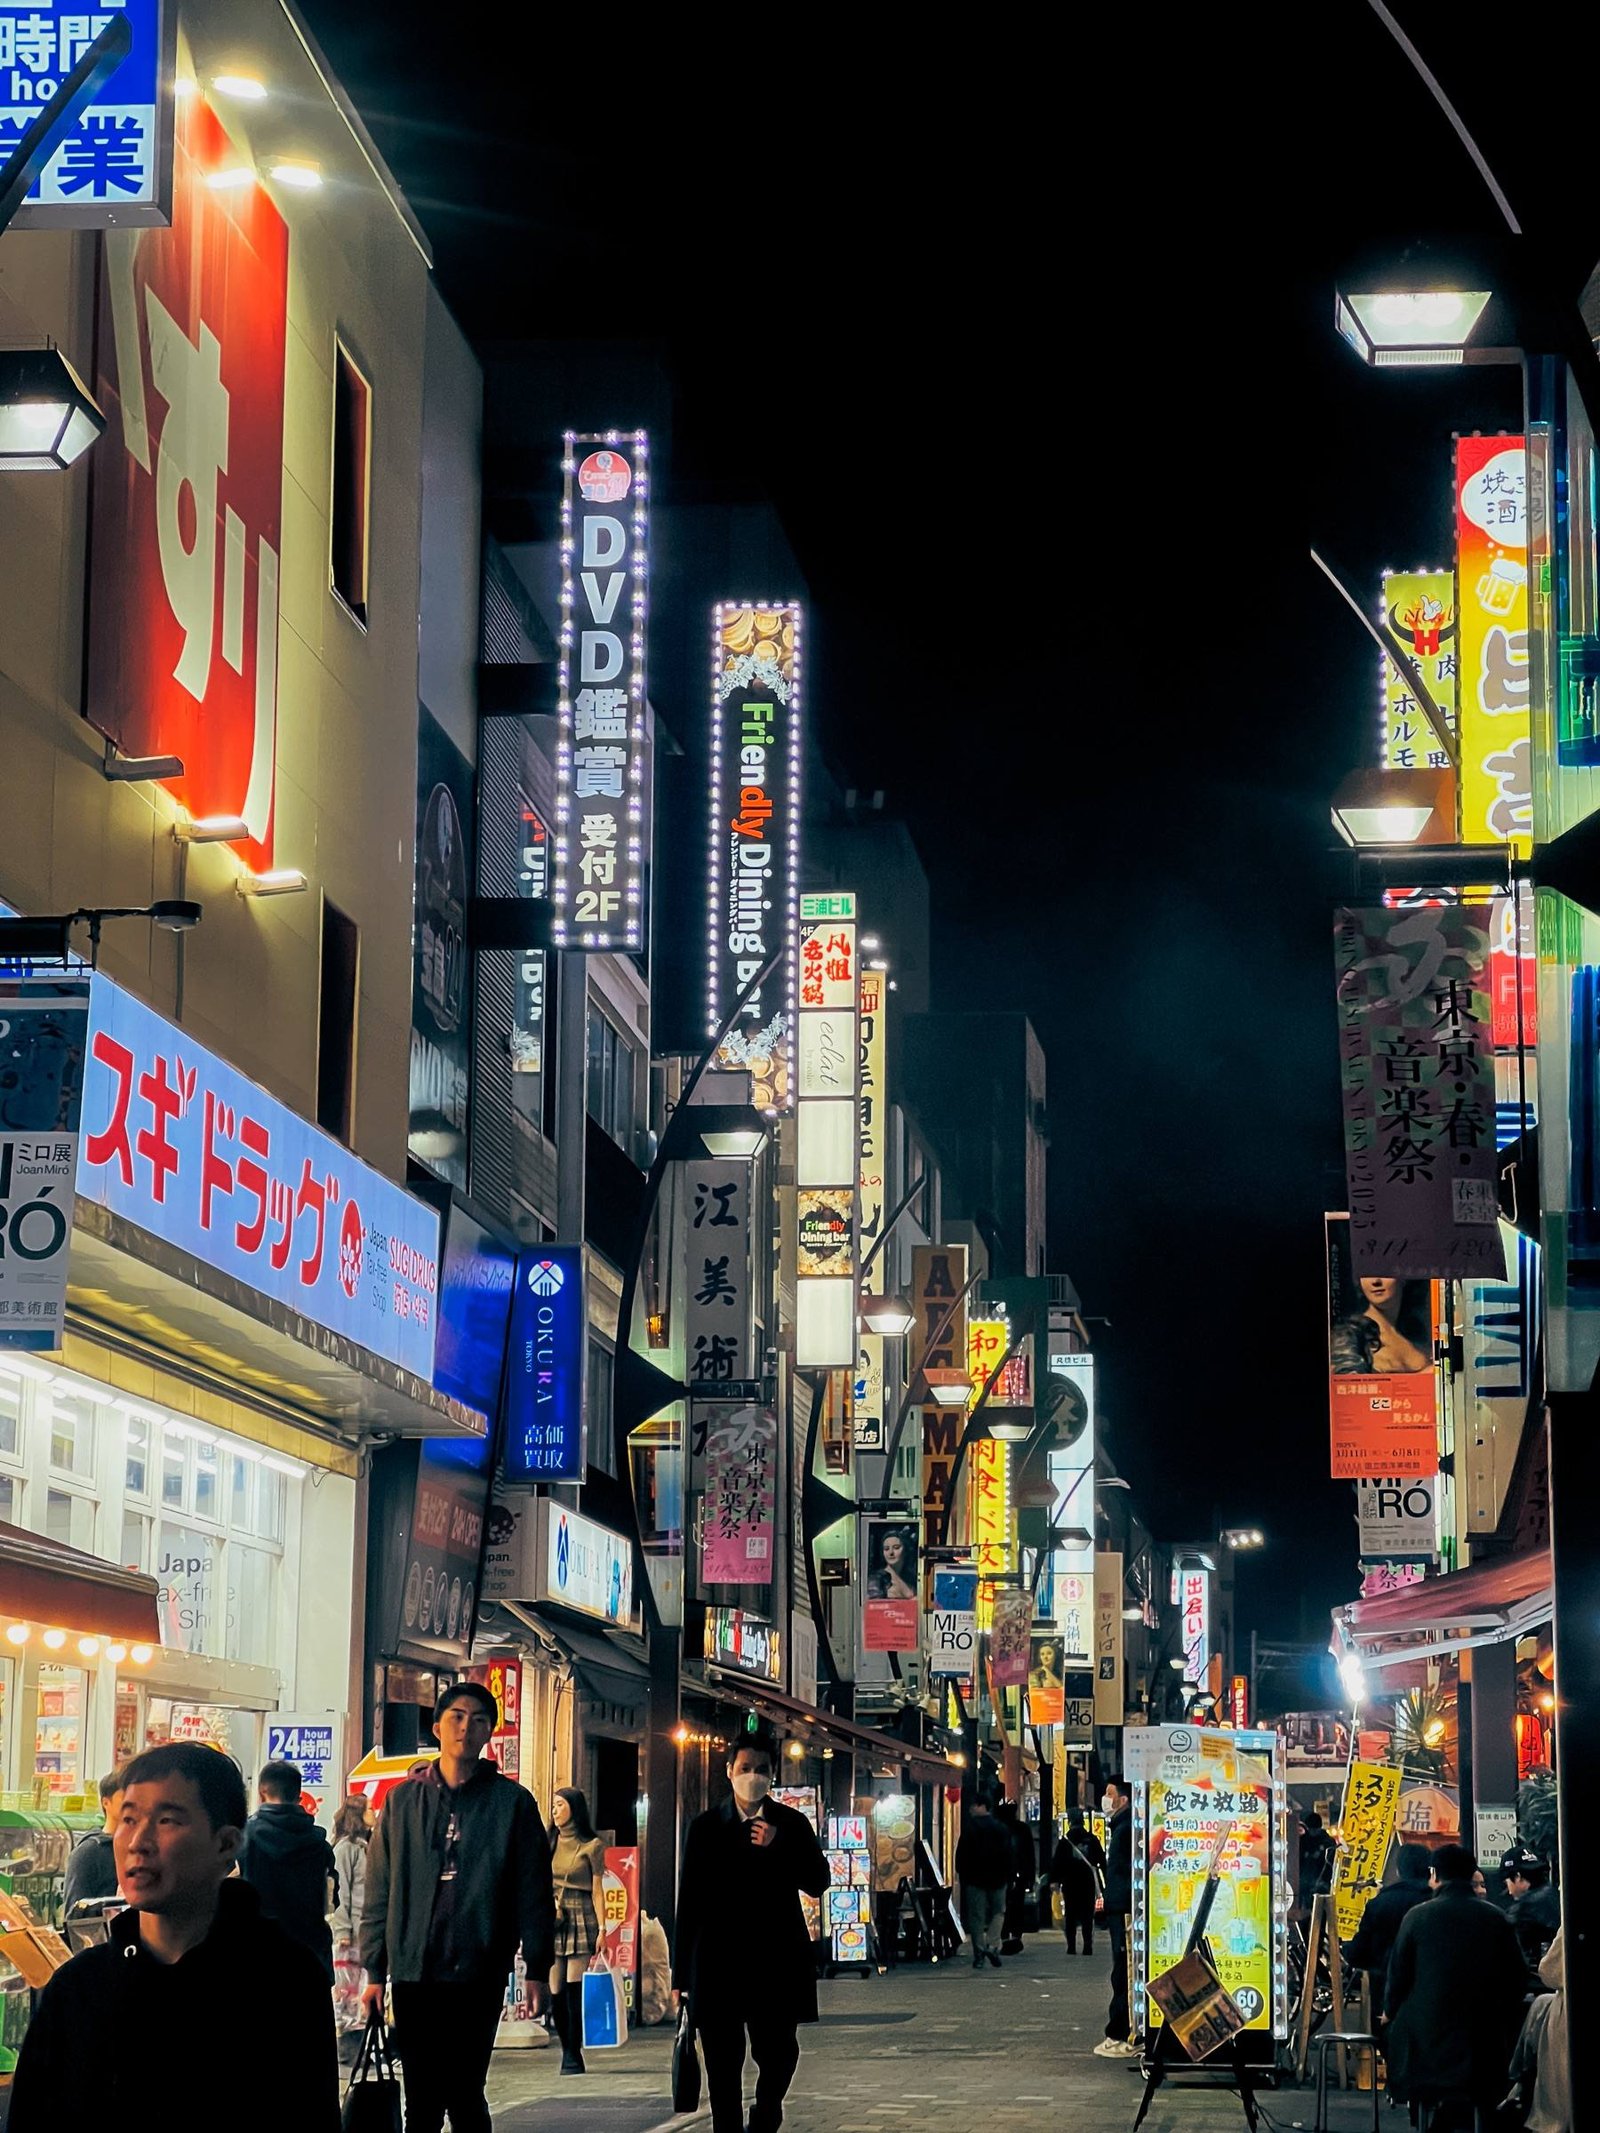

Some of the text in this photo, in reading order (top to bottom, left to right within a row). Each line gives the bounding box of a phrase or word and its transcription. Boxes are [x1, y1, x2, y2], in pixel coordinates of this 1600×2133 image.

[730, 703, 775, 839] Friendly
[728, 843, 772, 954] Dining
[801, 926, 814, 938] 4F
[1376, 1034, 1436, 1185] 音楽祭
[18, 1143, 72, 1163] ミロ展
[86, 1030, 341, 1288] スギドラッグ
[16, 1164, 43, 1175] Joan
[800, 1231, 833, 1244] Dining
[805, 1220, 845, 1233] Friendly
[524, 1339, 533, 1373] TOKYO
[537, 1306, 554, 1404] OKURA
[719, 1465, 742, 1540] 音楽祭
[1378, 1479, 1432, 1519] RÓ
[934, 1613, 957, 1632] MI
[940, 1627, 973, 1650] RÓ
[1069, 1710, 1092, 1726] RÓ
[270, 1728, 300, 1760] 24
[304, 1728, 329, 1739] hour
[301, 1739, 332, 1760] 時間
[1164, 1790, 1259, 1815] 飲み放題
[1401, 1800, 1423, 1831] 塩
[1236, 1991, 1257, 2008] 60
